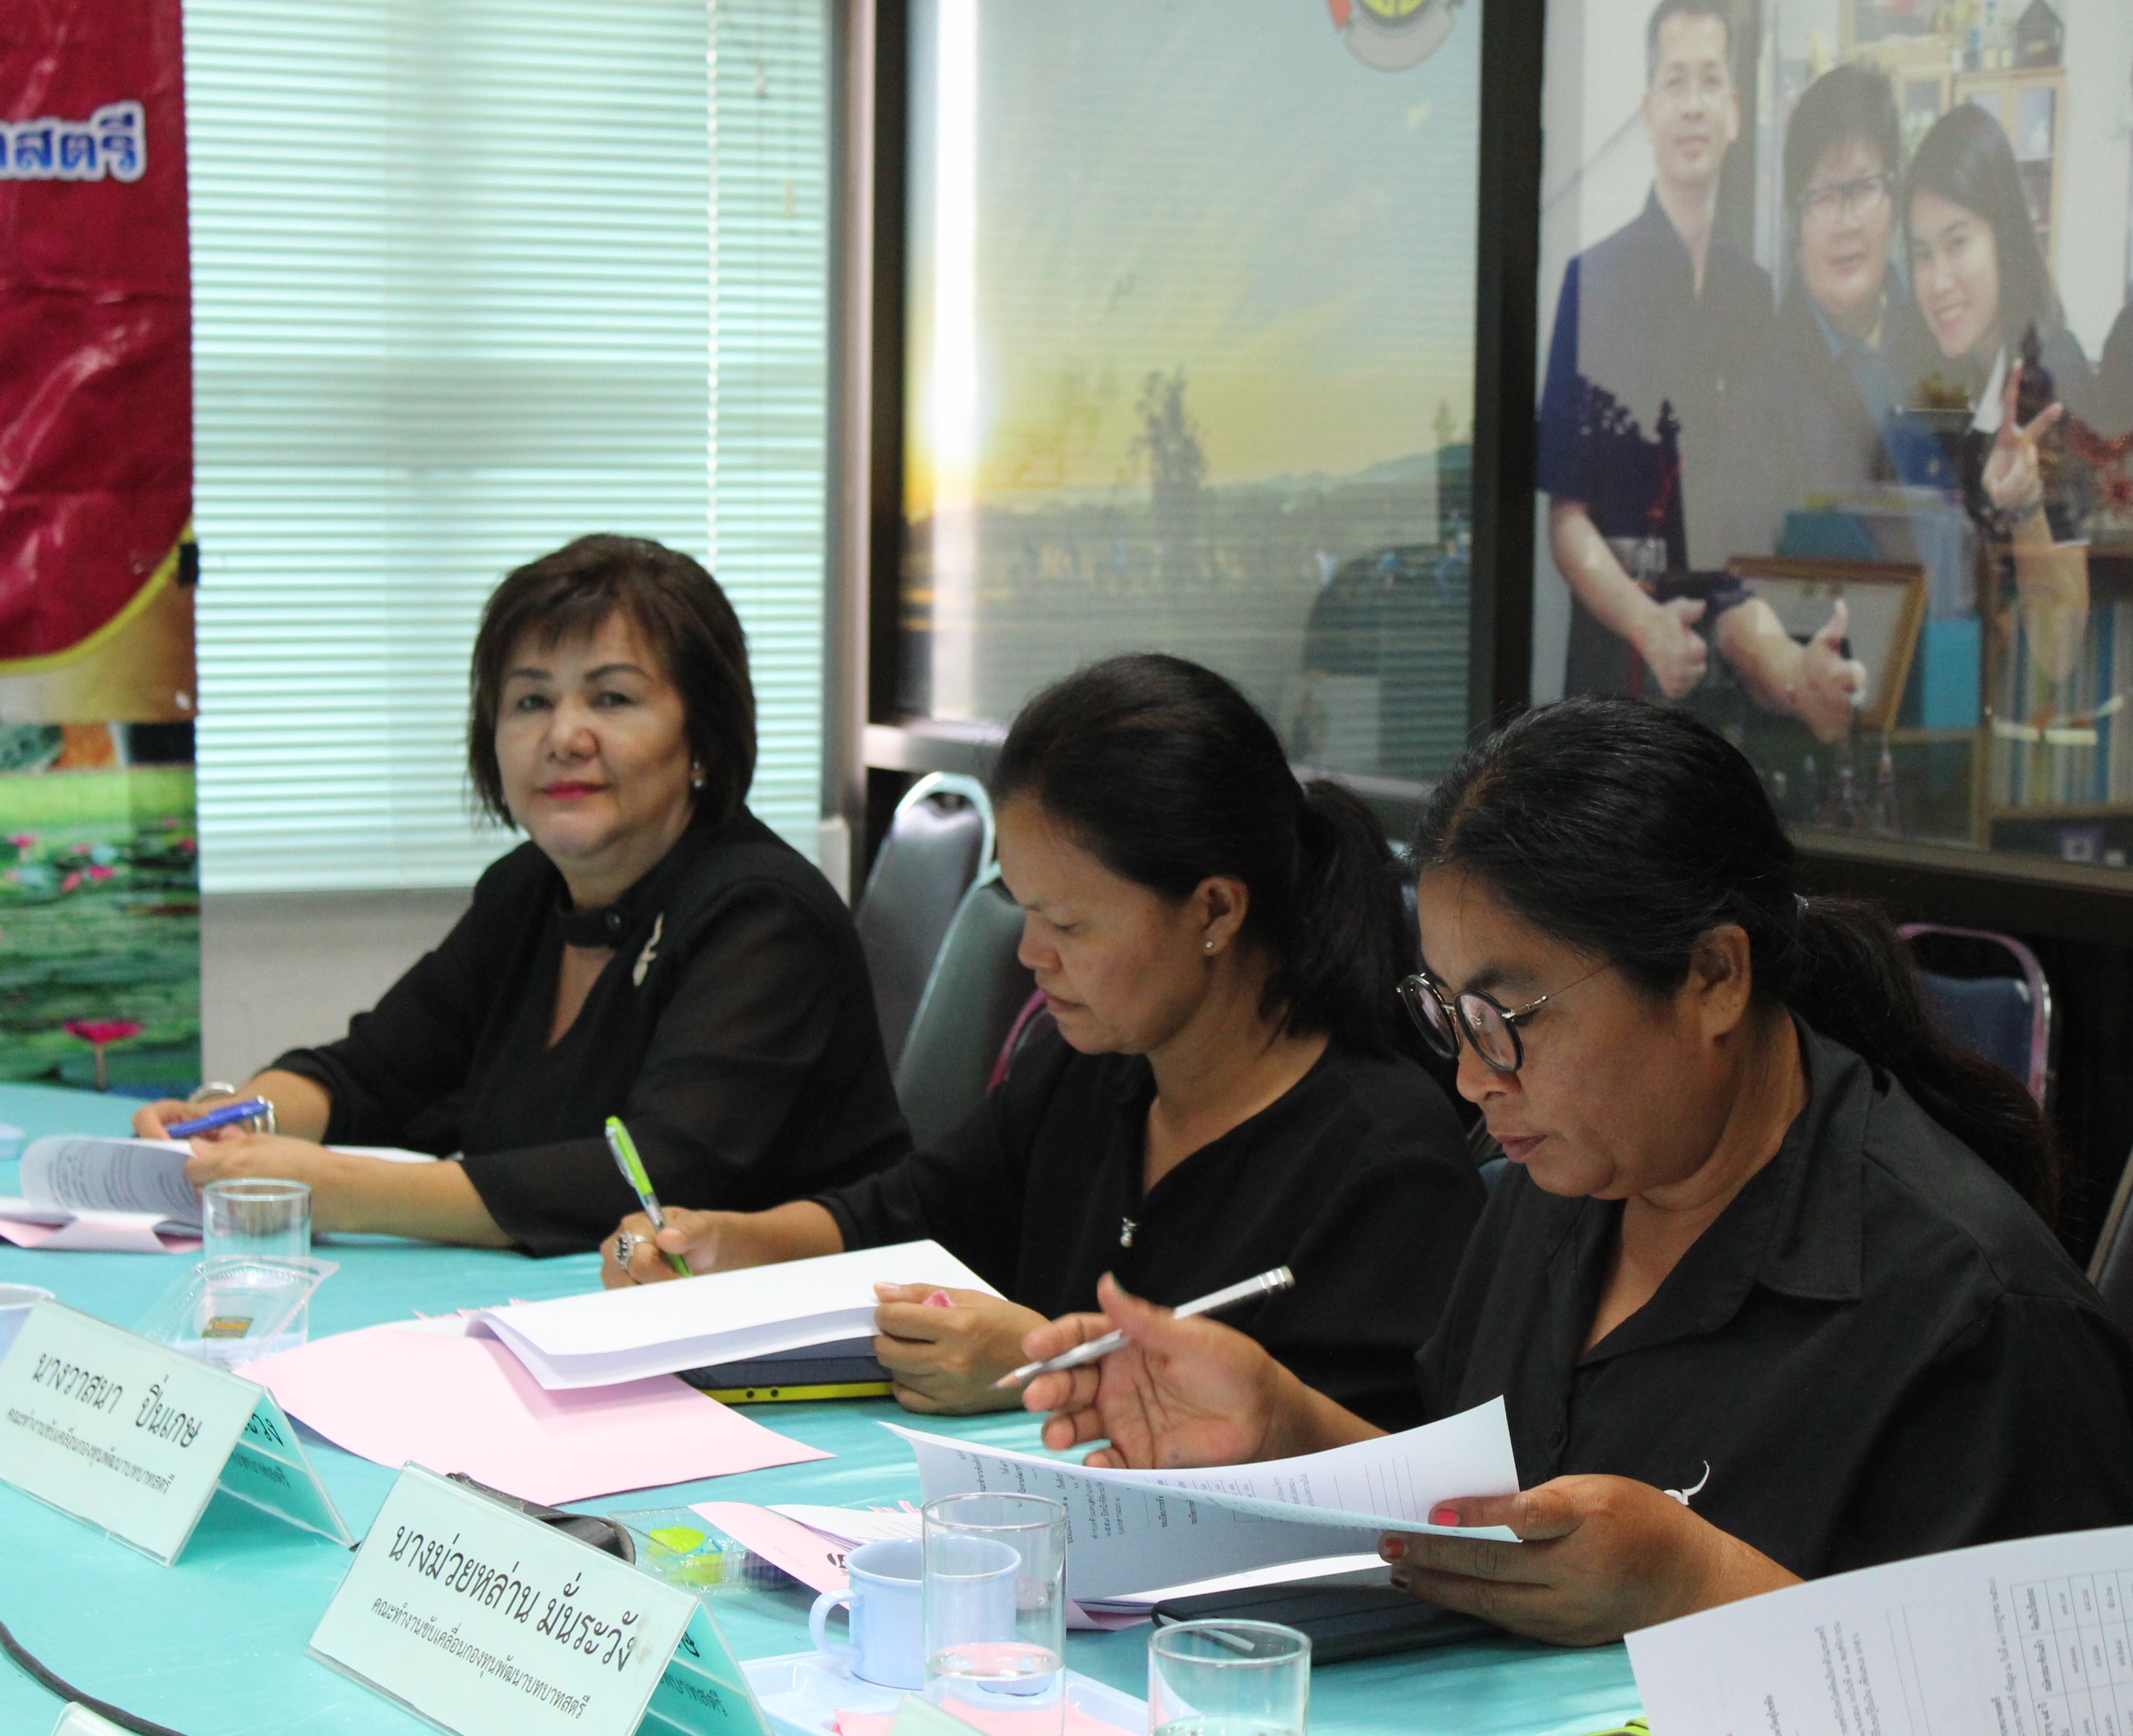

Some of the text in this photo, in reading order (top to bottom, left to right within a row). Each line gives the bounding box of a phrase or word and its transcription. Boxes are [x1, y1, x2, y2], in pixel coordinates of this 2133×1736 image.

[0, 99, 147, 183] สตรี
[32, 1353, 123, 1414] นางวาสนา
[389, 1525, 638, 1673] นางม่วยหล่าน มั่นระวัง
[371, 1597, 591, 1720] คณะทำงานขับเคลื่อนกองทุนพัฒนาบทบาทสตรี
